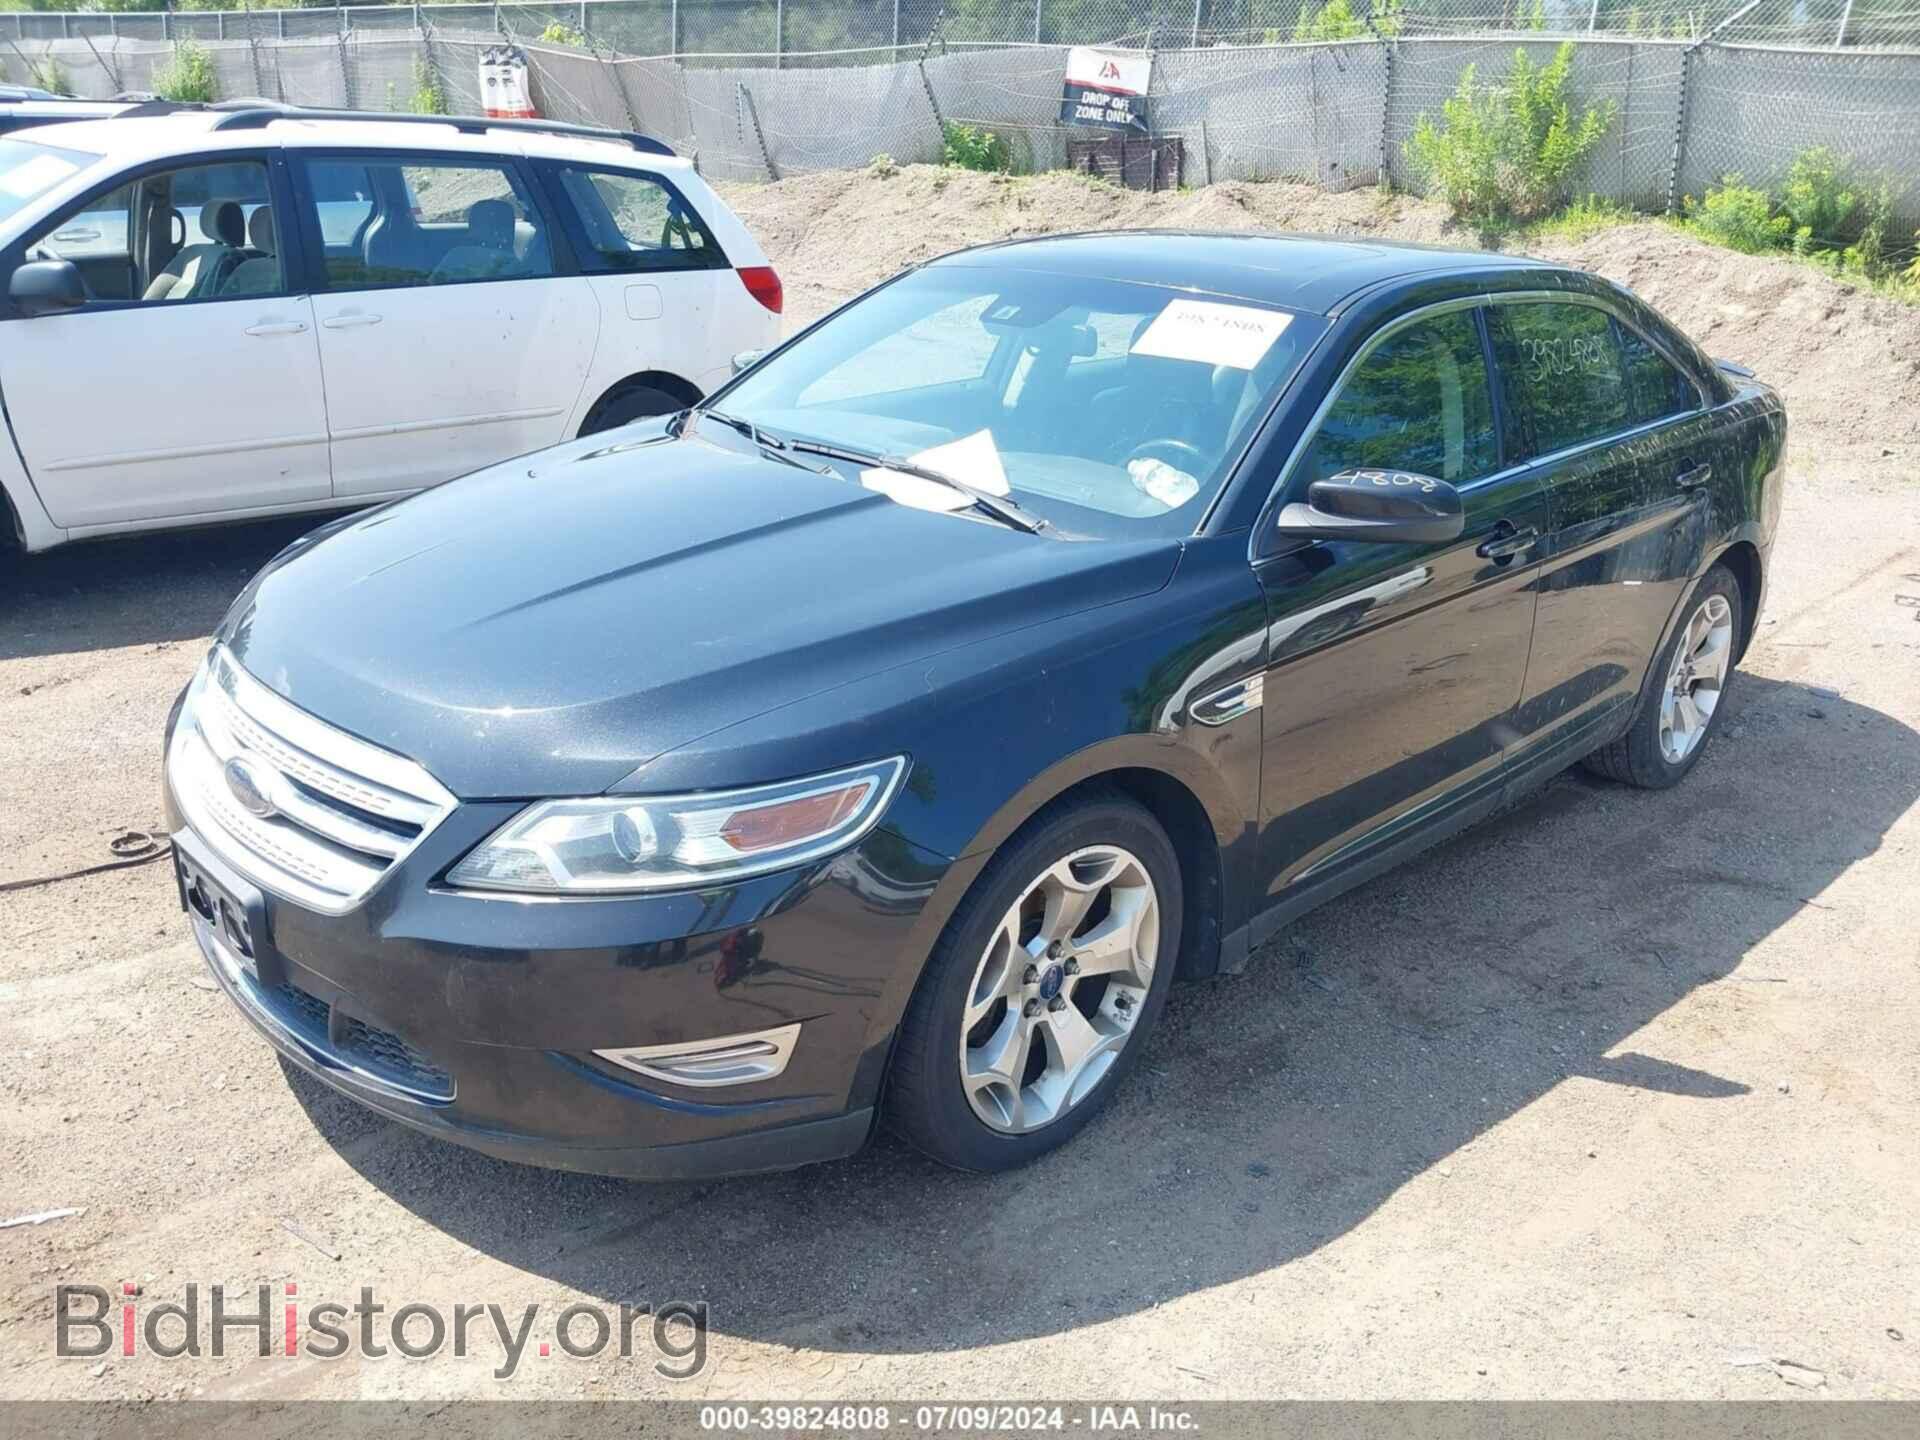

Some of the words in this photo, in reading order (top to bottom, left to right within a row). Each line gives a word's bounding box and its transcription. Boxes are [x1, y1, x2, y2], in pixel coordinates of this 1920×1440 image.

[1081, 91, 1110, 106] DROP
[1112, 98, 1130, 111] OFF
[1075, 105, 1103, 121] ZONE
[1105, 110, 1134, 124] ONLY
